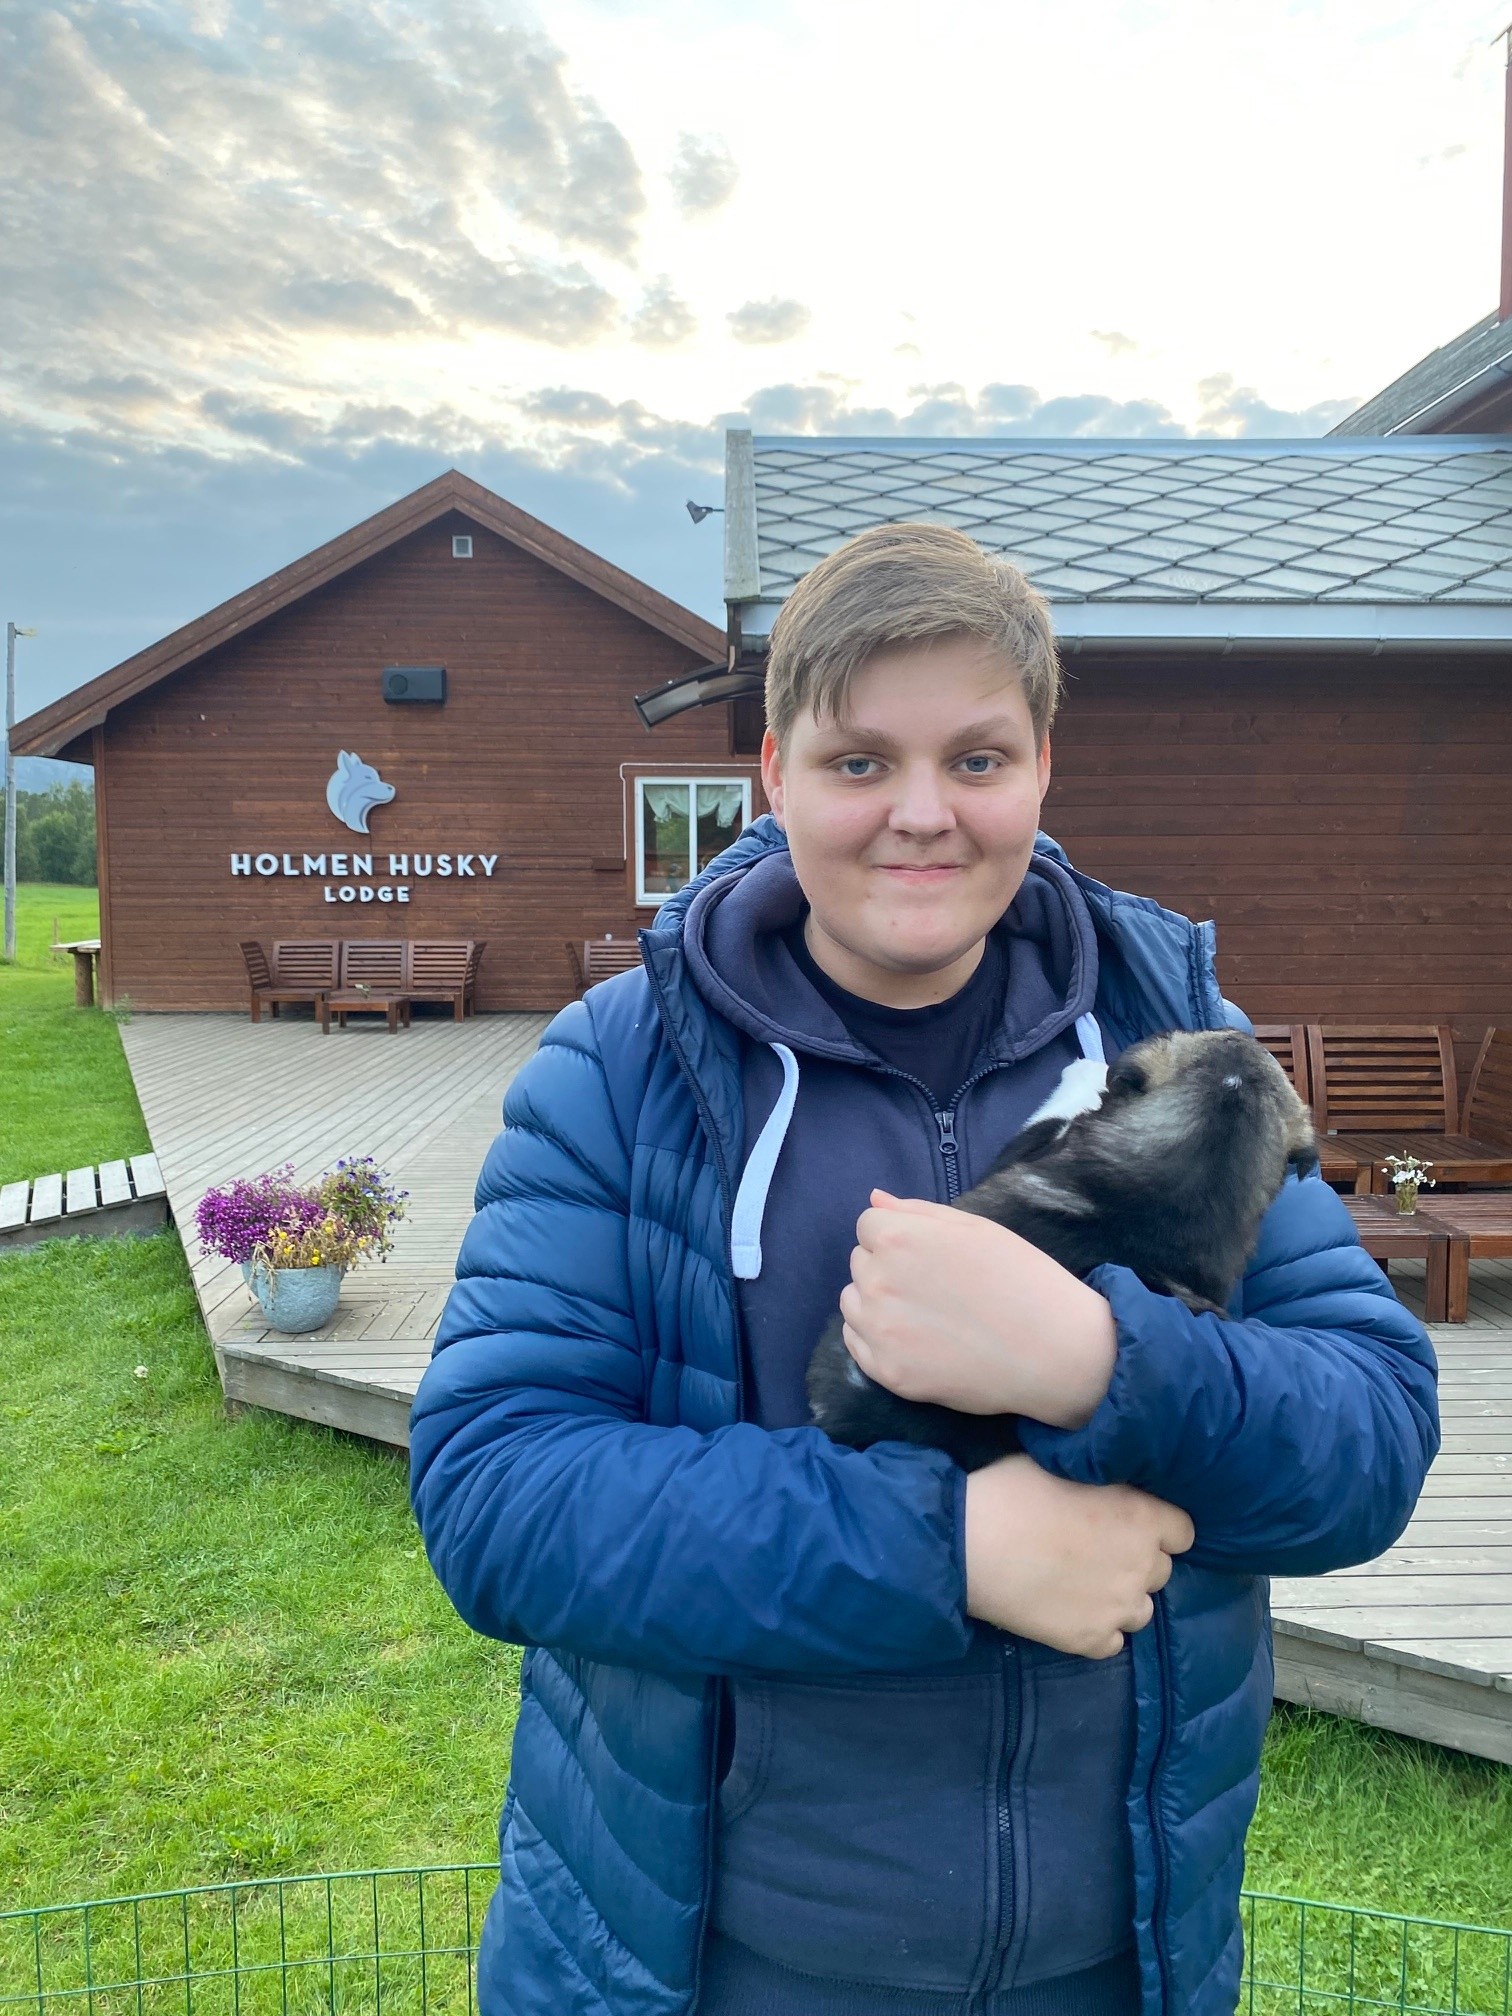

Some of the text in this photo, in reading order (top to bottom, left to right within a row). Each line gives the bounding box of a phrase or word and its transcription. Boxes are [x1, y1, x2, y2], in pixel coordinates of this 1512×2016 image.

[230, 853, 499, 877] HOLMEN HUSKY
[324, 885, 410, 903] LODGE
